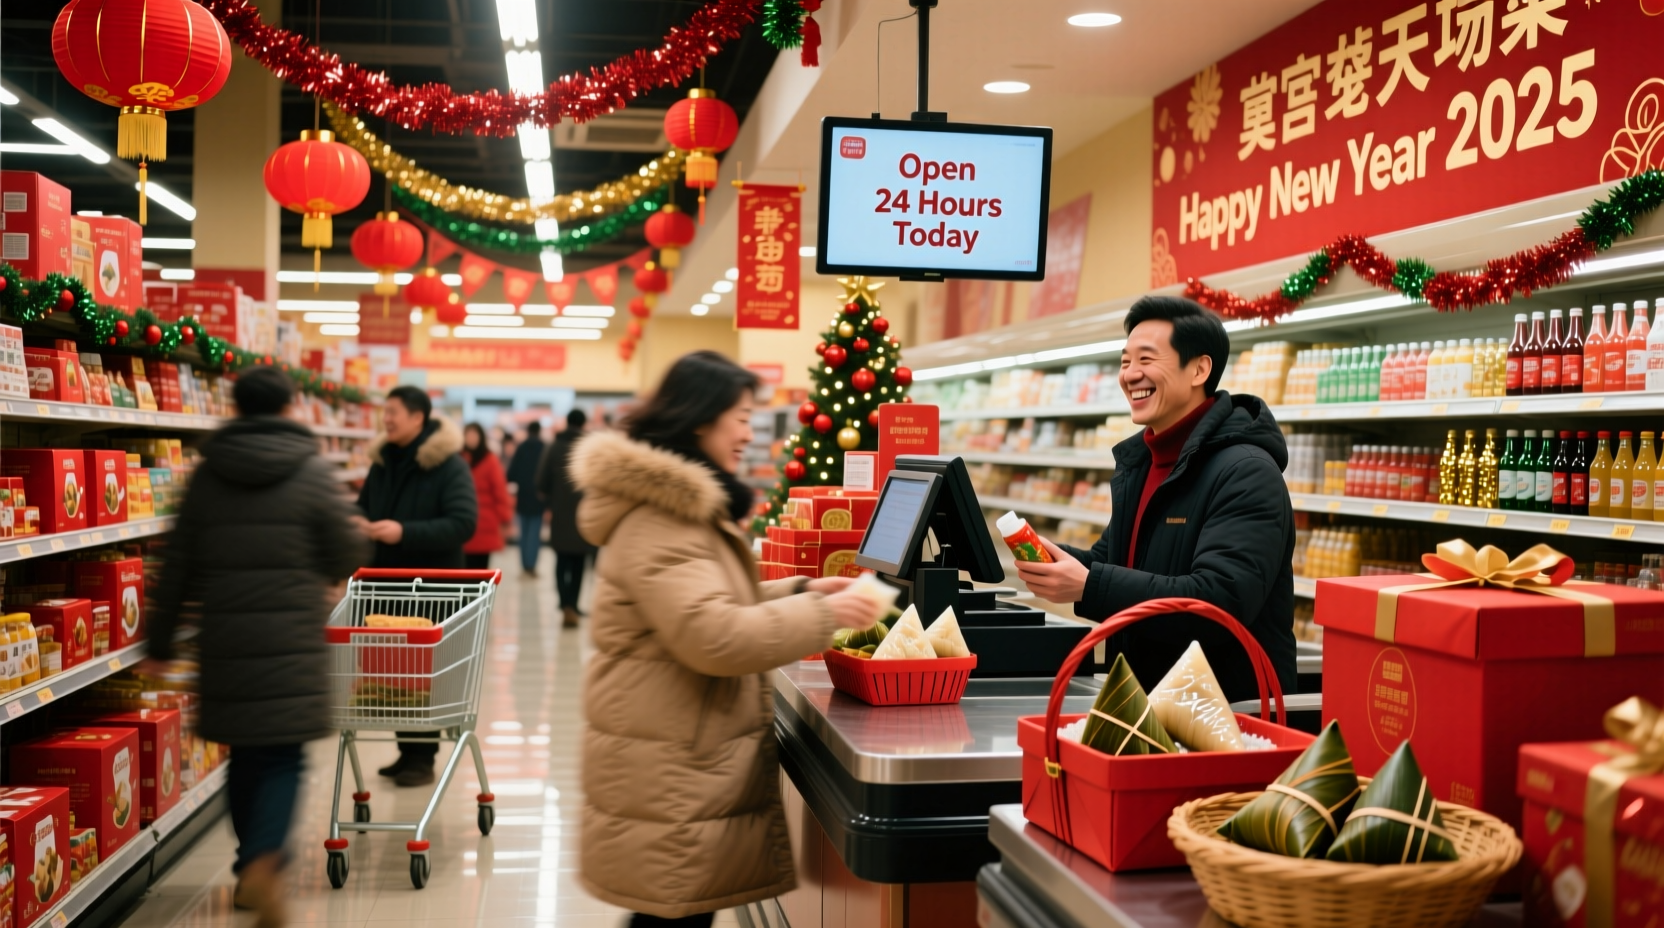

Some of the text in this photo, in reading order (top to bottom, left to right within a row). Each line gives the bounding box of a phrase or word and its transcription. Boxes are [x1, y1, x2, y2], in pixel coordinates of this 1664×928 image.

[1179, 48, 1598, 250] Happy New Year 2025
[898, 152, 976, 186] Open
[874, 188, 1002, 217] 24 Hours
[892, 220, 979, 255] Today
